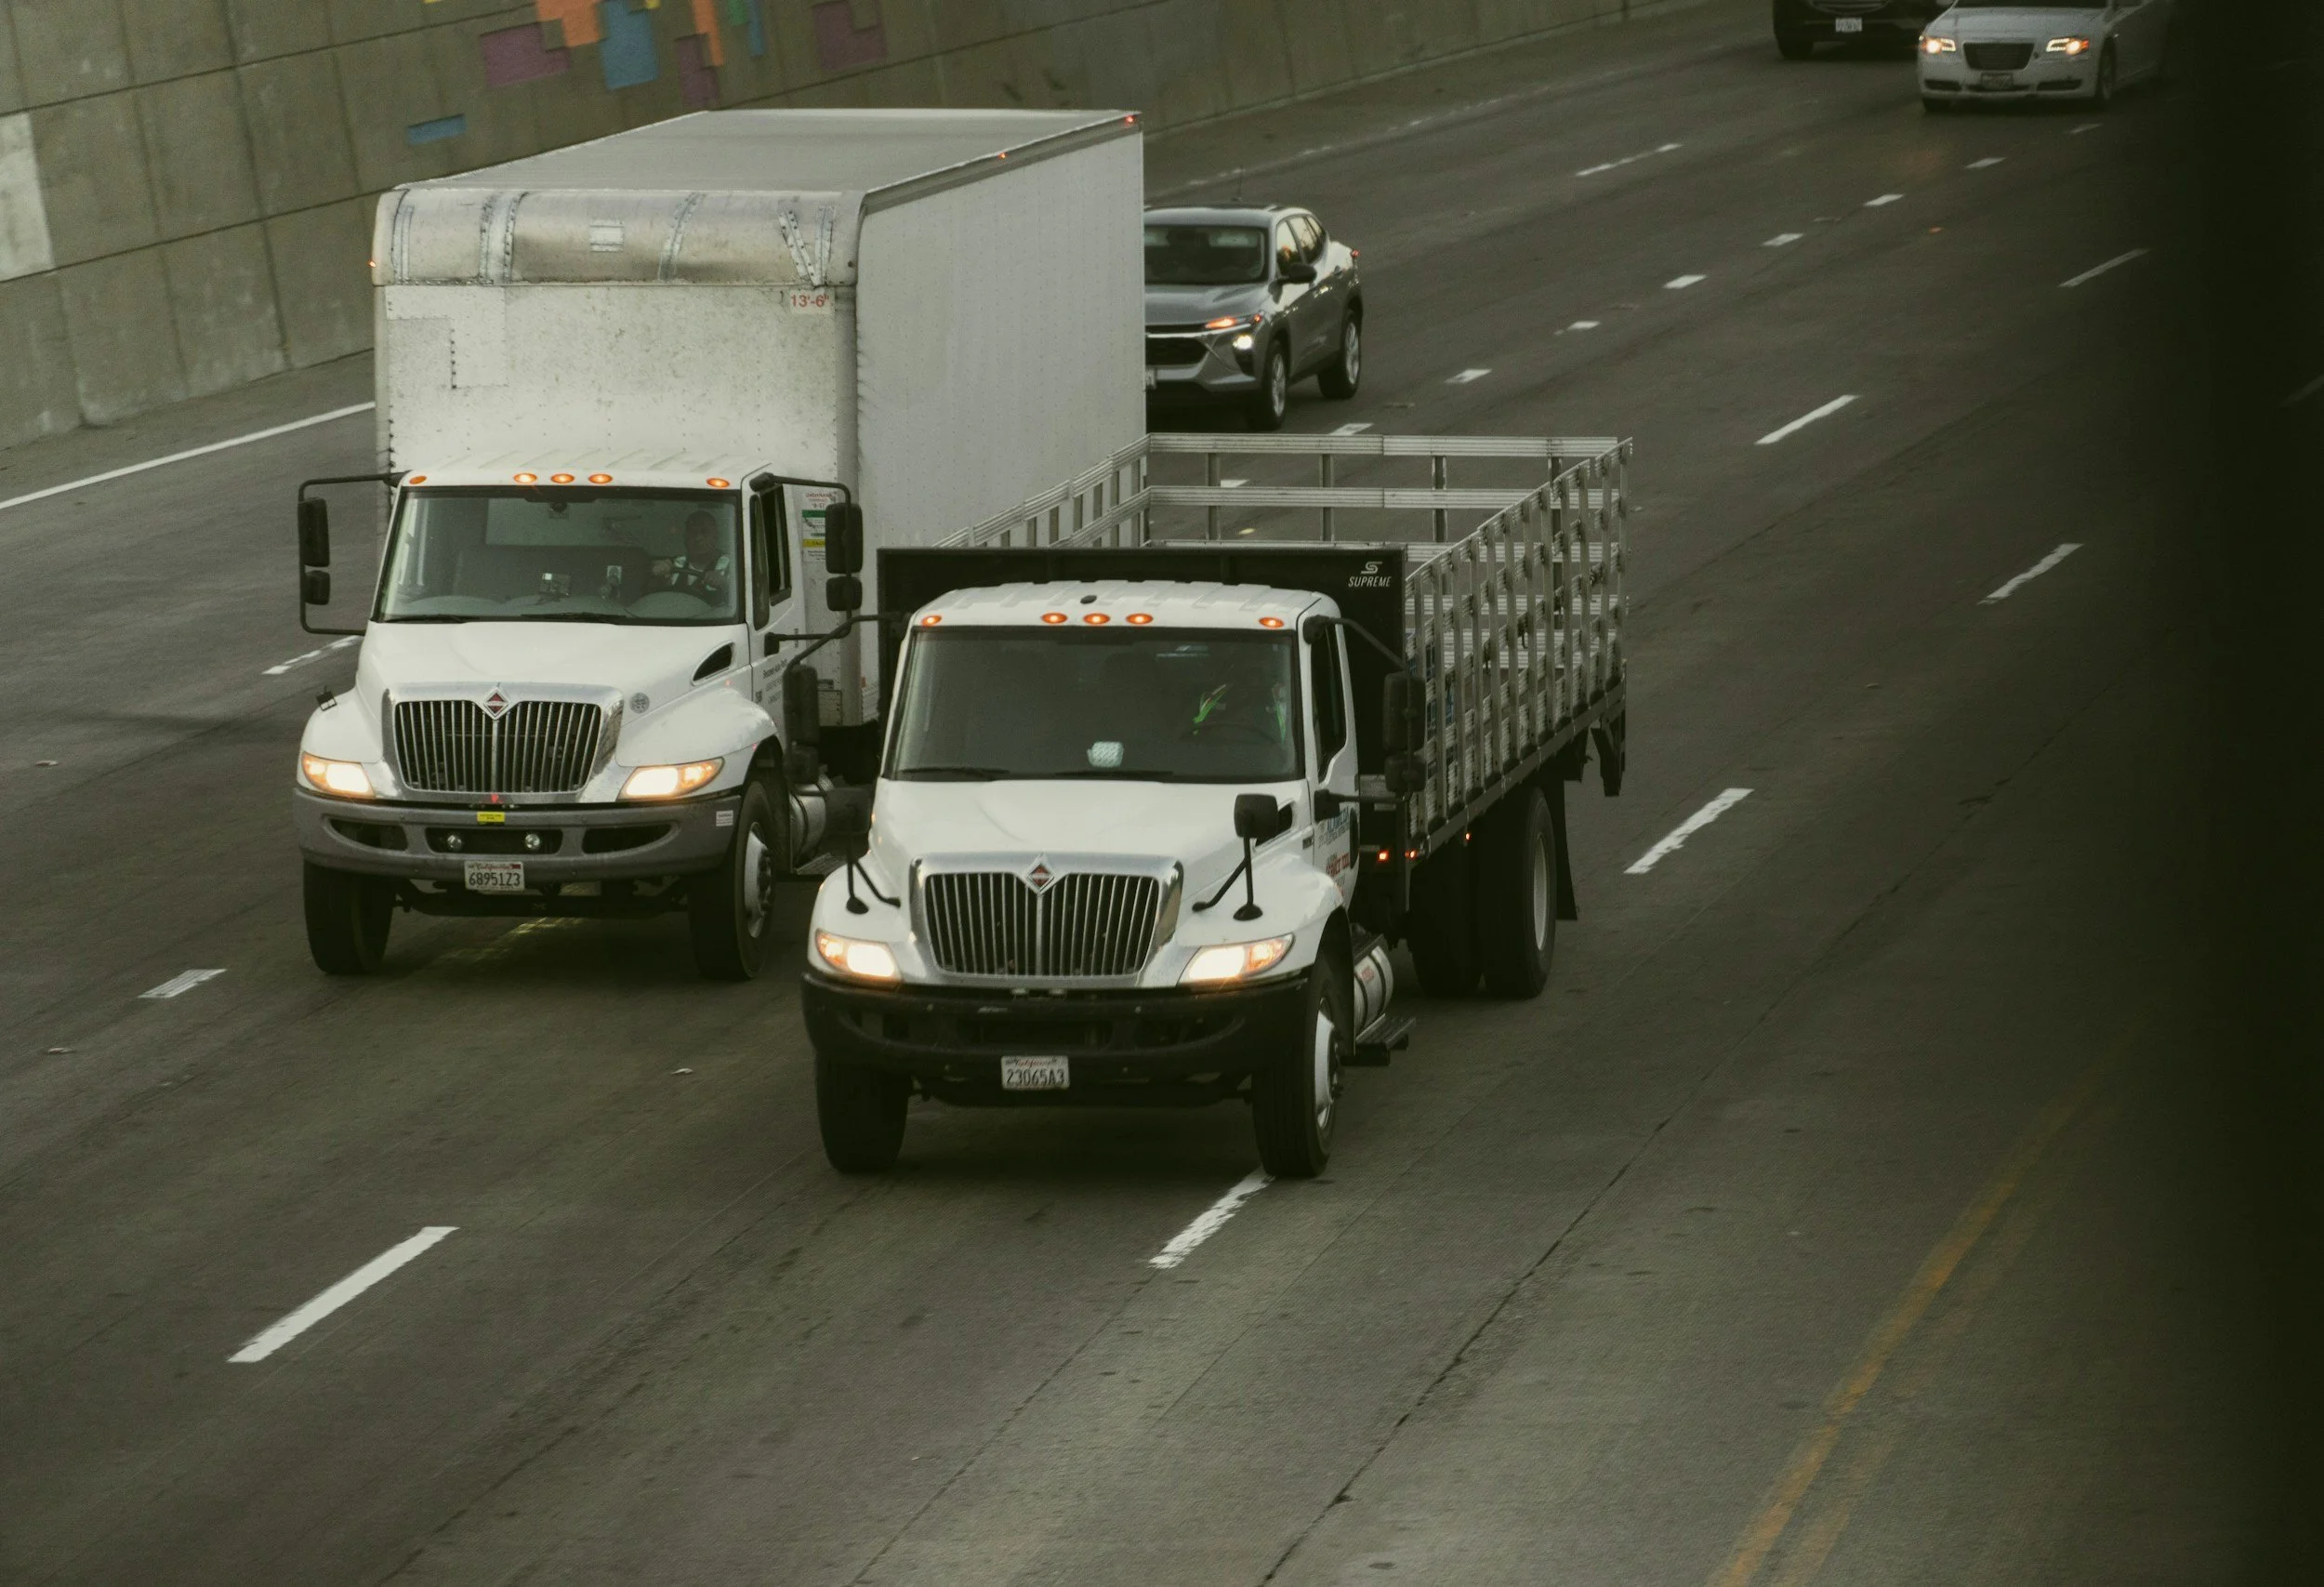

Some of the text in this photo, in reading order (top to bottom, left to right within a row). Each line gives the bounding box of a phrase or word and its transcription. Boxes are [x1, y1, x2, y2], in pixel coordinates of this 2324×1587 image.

[790, 293, 830, 308] 13'-6"
[1348, 575, 1393, 588] SUPREME
[469, 872, 521, 887] 68951Z3
[1006, 1067, 1065, 1087] 23065A3
